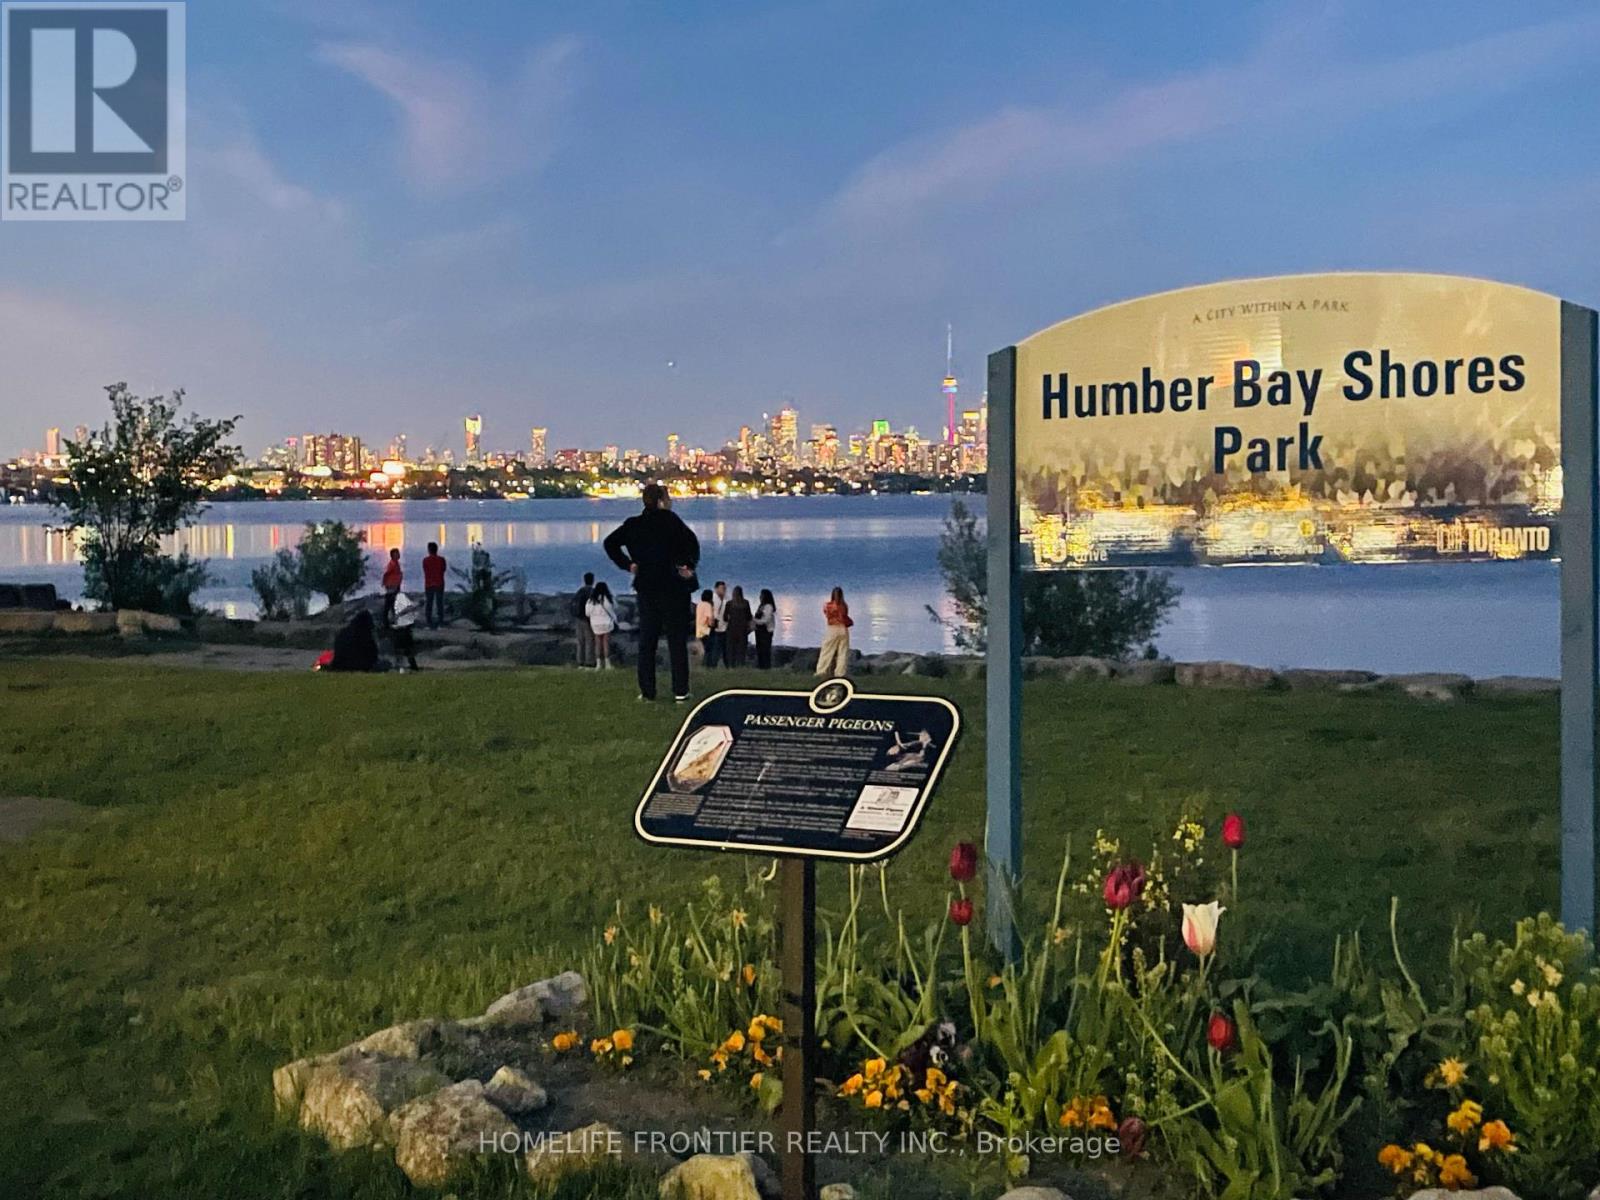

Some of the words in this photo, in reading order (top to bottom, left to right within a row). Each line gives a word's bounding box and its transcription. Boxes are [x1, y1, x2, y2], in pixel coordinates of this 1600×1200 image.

[1193, 313, 1202, 324] A
[1206, 307, 1235, 321] CITY
[1239, 301, 1291, 314] WITHIN
[1296, 300, 1306, 310] A
[1312, 299, 1349, 312] PARK
[1042, 366, 1214, 420] Humber
[1233, 359, 1323, 416] Bay
[1342, 349, 1526, 402] Shores
[1214, 421, 1324, 475] Park
[1465, 522, 1551, 554] TORONTO
[743, 714, 825, 728] PASSENGER
[828, 718, 895, 731] PIGEONS
